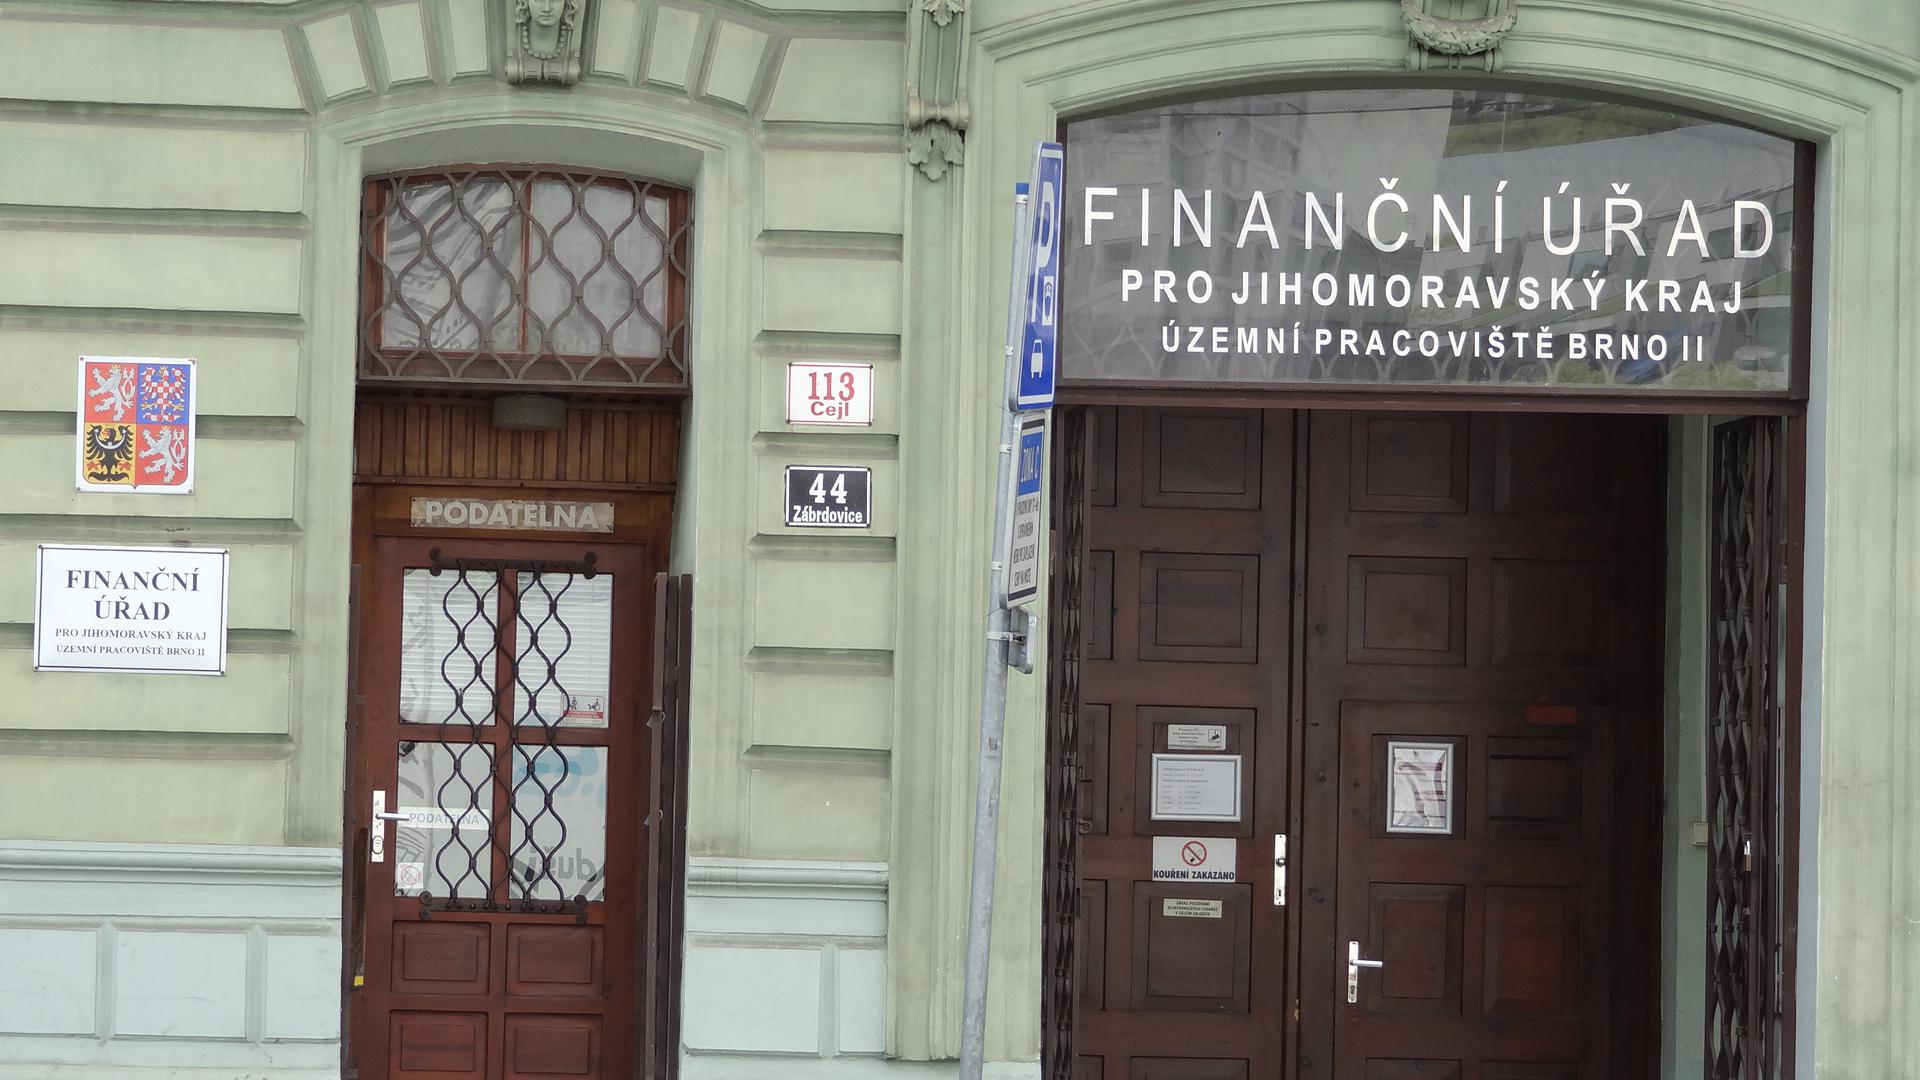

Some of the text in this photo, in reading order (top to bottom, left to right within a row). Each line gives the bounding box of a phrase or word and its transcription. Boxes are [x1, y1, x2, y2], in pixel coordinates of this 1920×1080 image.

[1084, 177, 1774, 258] FINANČNÍ ÚŘAD
[1121, 269, 1741, 314] PRO JIHOMORAVSKÝ KRAJ
[1162, 319, 1703, 362] ÚZEMNÍ PRACOVIŠTĚ BRNO II
[808, 371, 855, 401] 113
[810, 401, 849, 420] Cejl
[809, 472, 848, 504] 44
[425, 501, 600, 529] PODATELNA
[793, 504, 863, 523] Zábrdovice
[66, 567, 201, 592] FINANČNÍ
[94, 595, 170, 621] ÚŘAD
[55, 628, 207, 642] PRO JIHOMORAVSKÝ KRAJ
[56, 643, 205, 656] ÚZEMNÍ PRACOVIŠTĚ BRNO II
[1154, 868, 1234, 880] KOUŘENÍ ZAKÁZÁNO
